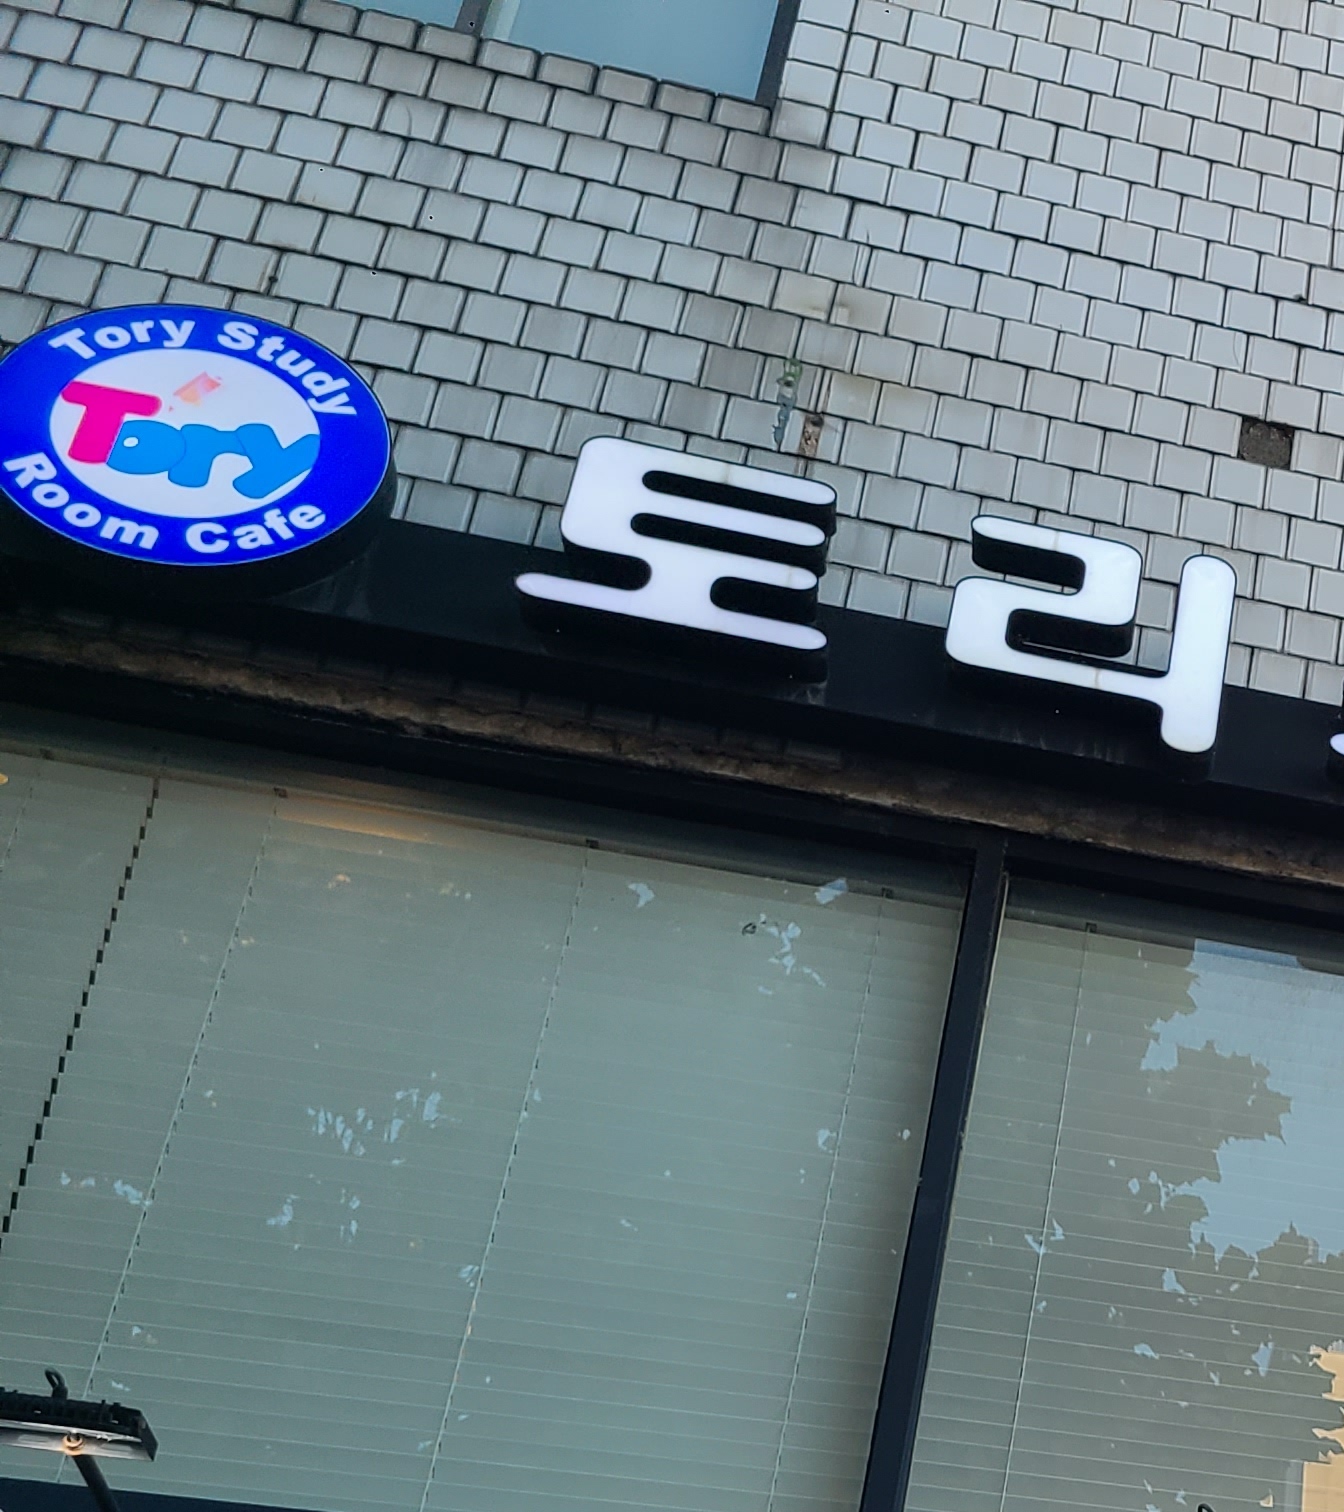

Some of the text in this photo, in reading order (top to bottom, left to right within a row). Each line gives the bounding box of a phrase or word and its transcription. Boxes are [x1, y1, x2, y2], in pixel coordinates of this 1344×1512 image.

[49, 319, 358, 419] Tory Study
[62, 380, 321, 499] Tory
[3, 451, 326, 554] Room Cafe
